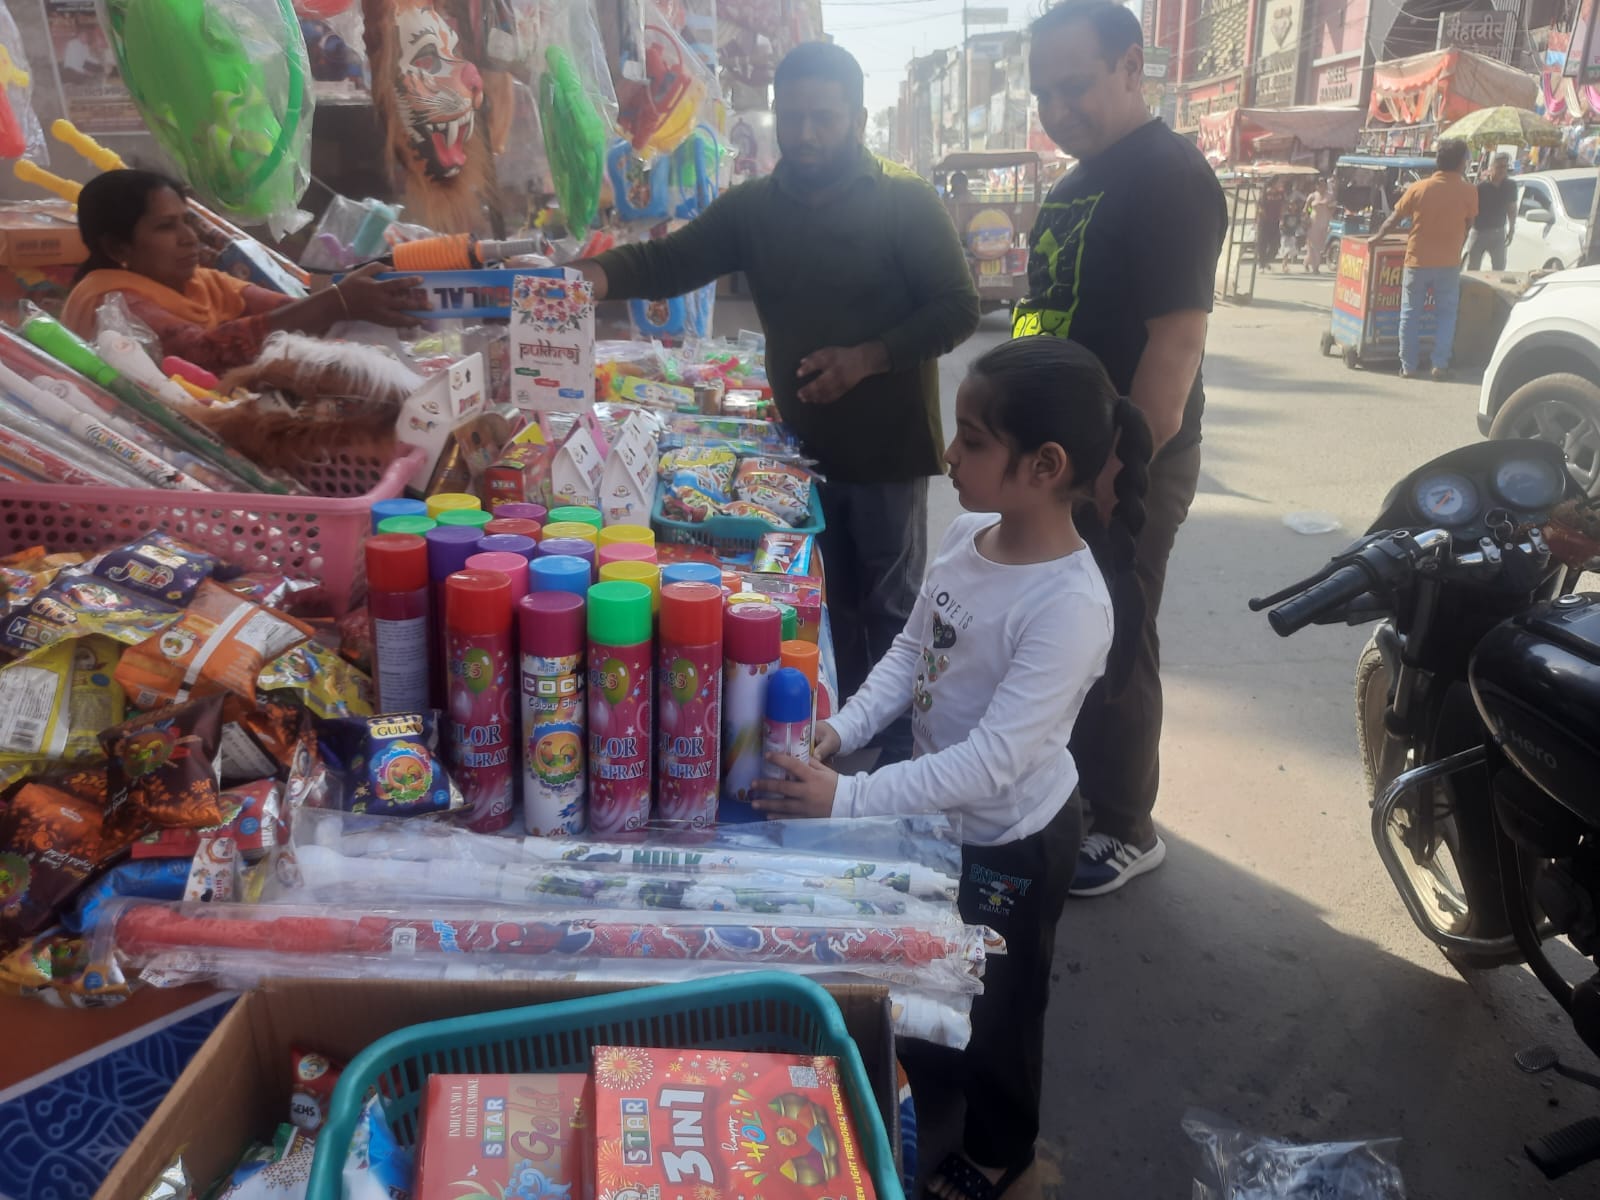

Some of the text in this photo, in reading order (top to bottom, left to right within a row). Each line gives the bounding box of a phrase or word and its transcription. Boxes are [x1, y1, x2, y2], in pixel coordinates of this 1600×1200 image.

[931, 584, 973, 630] LOVE IS
[463, 746, 510, 768] SPRAY
[600, 760, 646, 780] SPRAY
[668, 760, 713, 779] SPRAY
[450, 1092, 462, 1104] NO
[466, 1078, 479, 1137] COLOUR SMOKE
[830, 1082, 845, 1115] FACTORY
[448, 1105, 462, 1137] INDIA'S
[485, 1098, 504, 1156] STAR
[505, 1085, 568, 1161] Gold
[626, 1101, 649, 1162] STAR
[721, 1115, 739, 1155] happy
[837, 1116, 855, 1160] FIREWORKS
[847, 1161, 862, 1184] LIGHT
